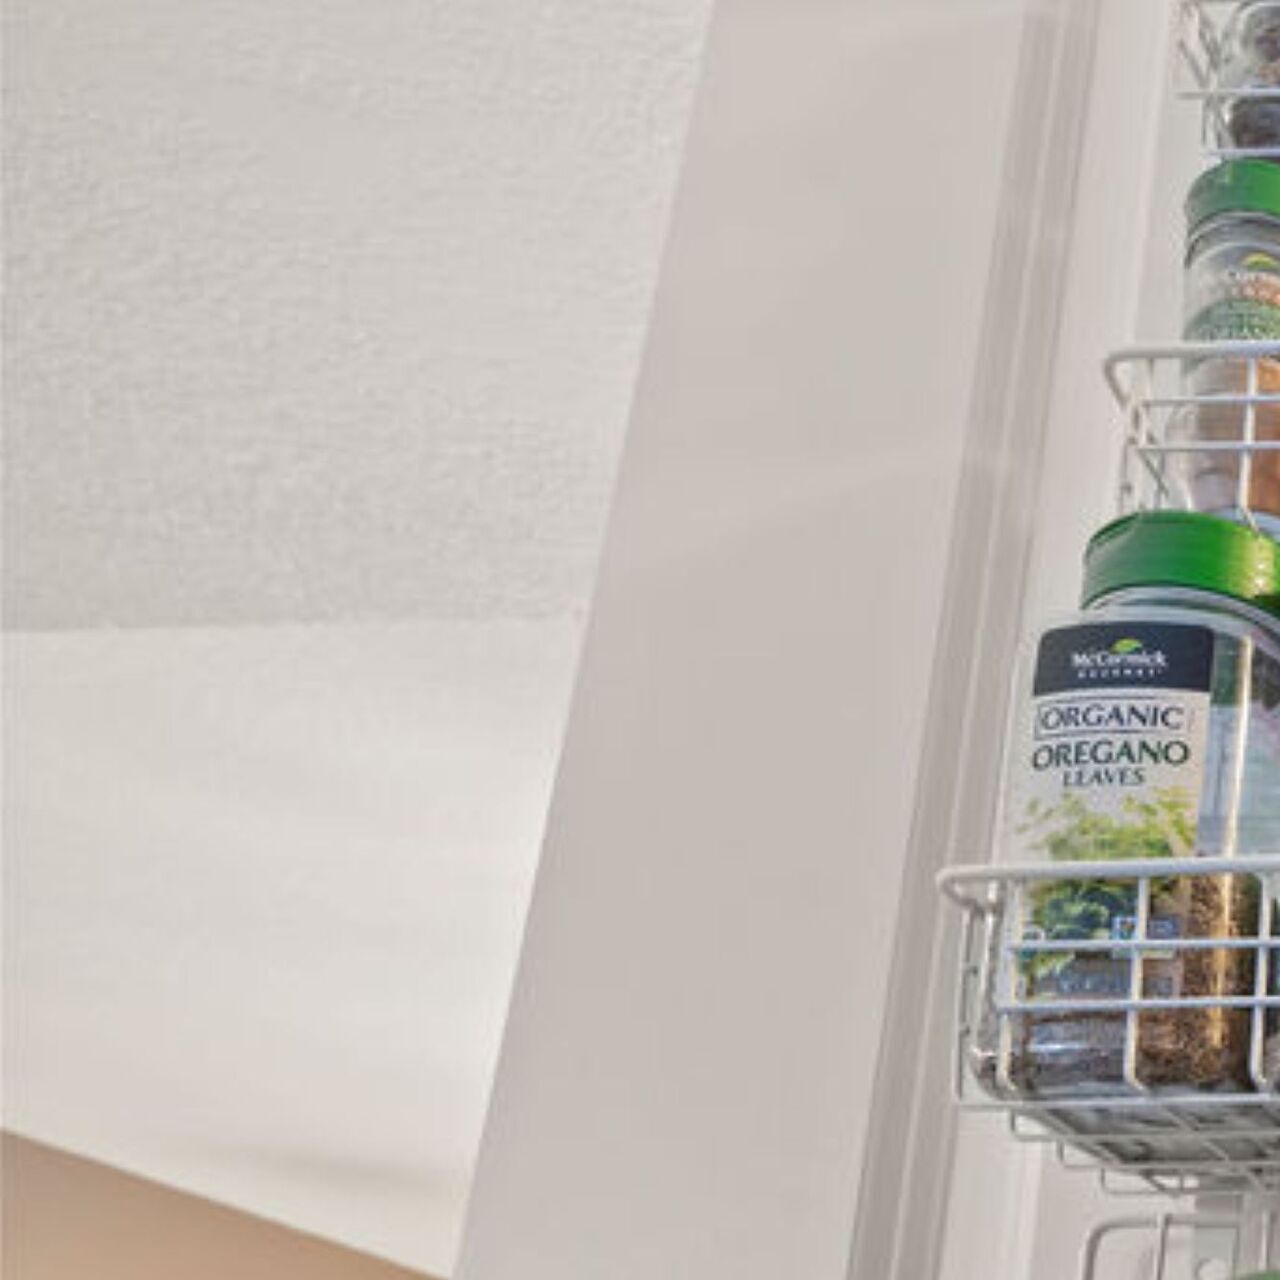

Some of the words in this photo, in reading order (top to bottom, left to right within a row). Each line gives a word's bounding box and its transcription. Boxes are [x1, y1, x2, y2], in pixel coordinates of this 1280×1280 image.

[1040, 704, 1184, 731] ORGANIC
[1033, 740, 1189, 770] OREGANO
[1063, 767, 1145, 787] LEAVES
